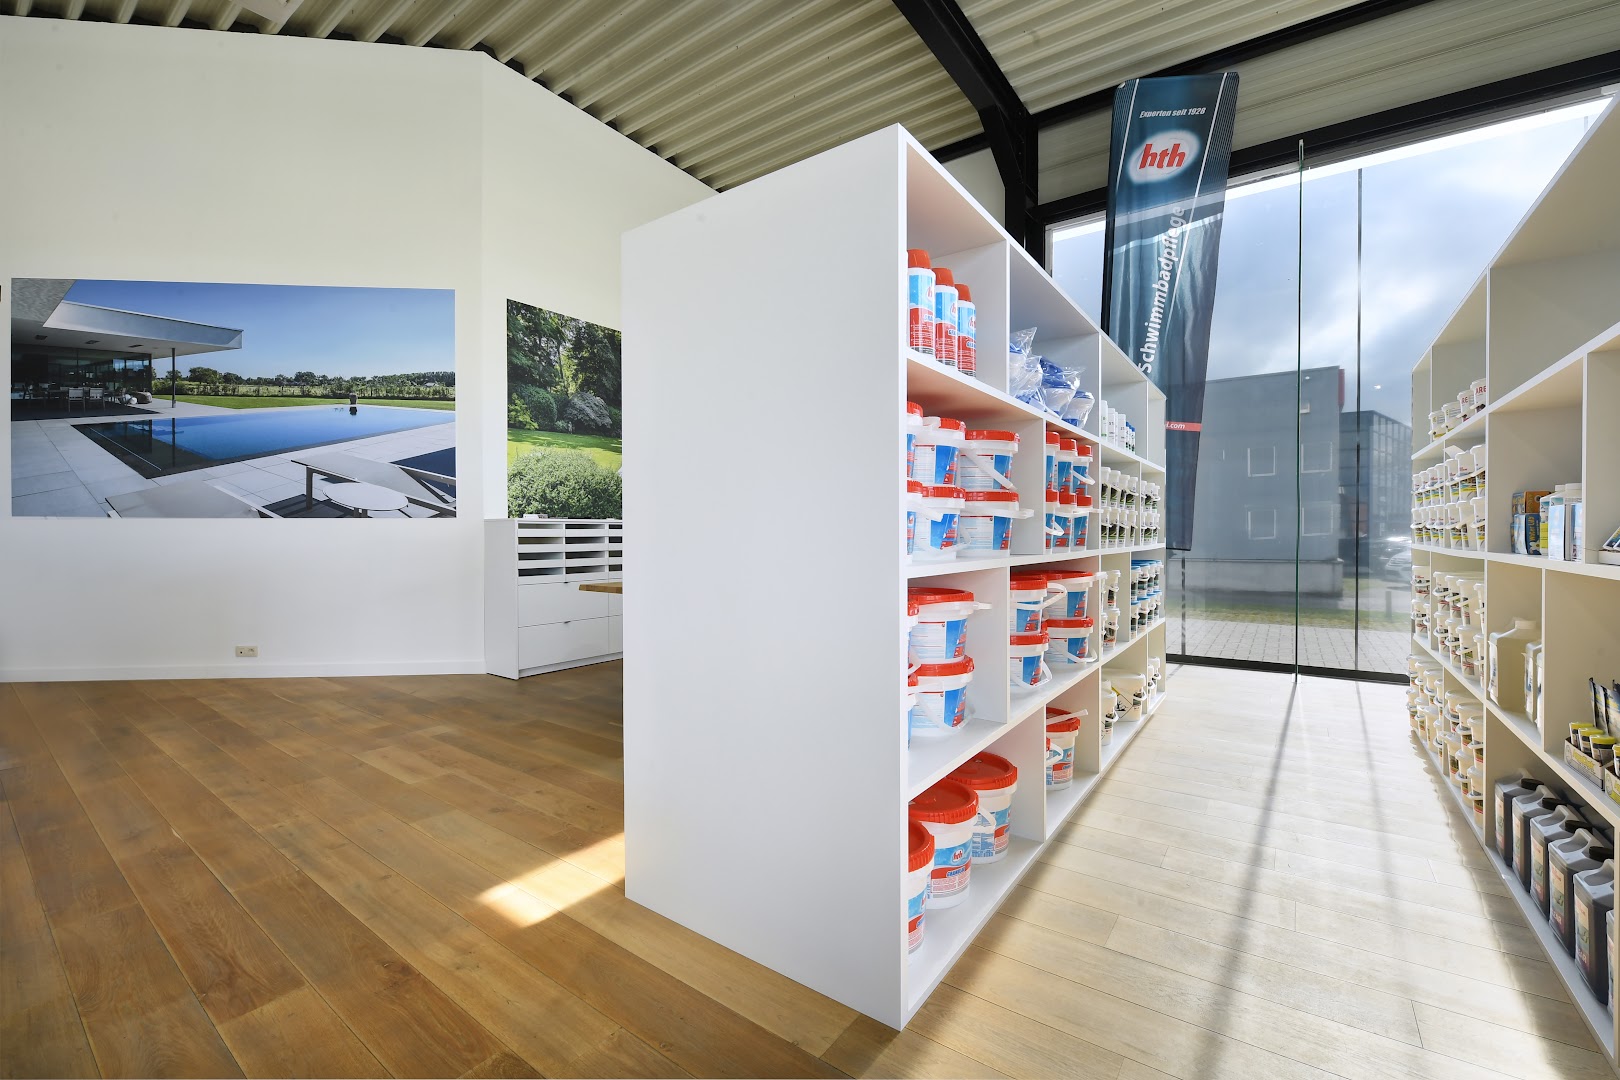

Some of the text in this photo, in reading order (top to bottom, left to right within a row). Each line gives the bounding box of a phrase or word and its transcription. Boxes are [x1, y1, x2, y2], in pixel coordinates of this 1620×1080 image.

[1139, 107, 1206, 118] Experten seit 1928
[1139, 143, 1186, 169] hth
[1137, 206, 1186, 374] Schwimmbadpflege
